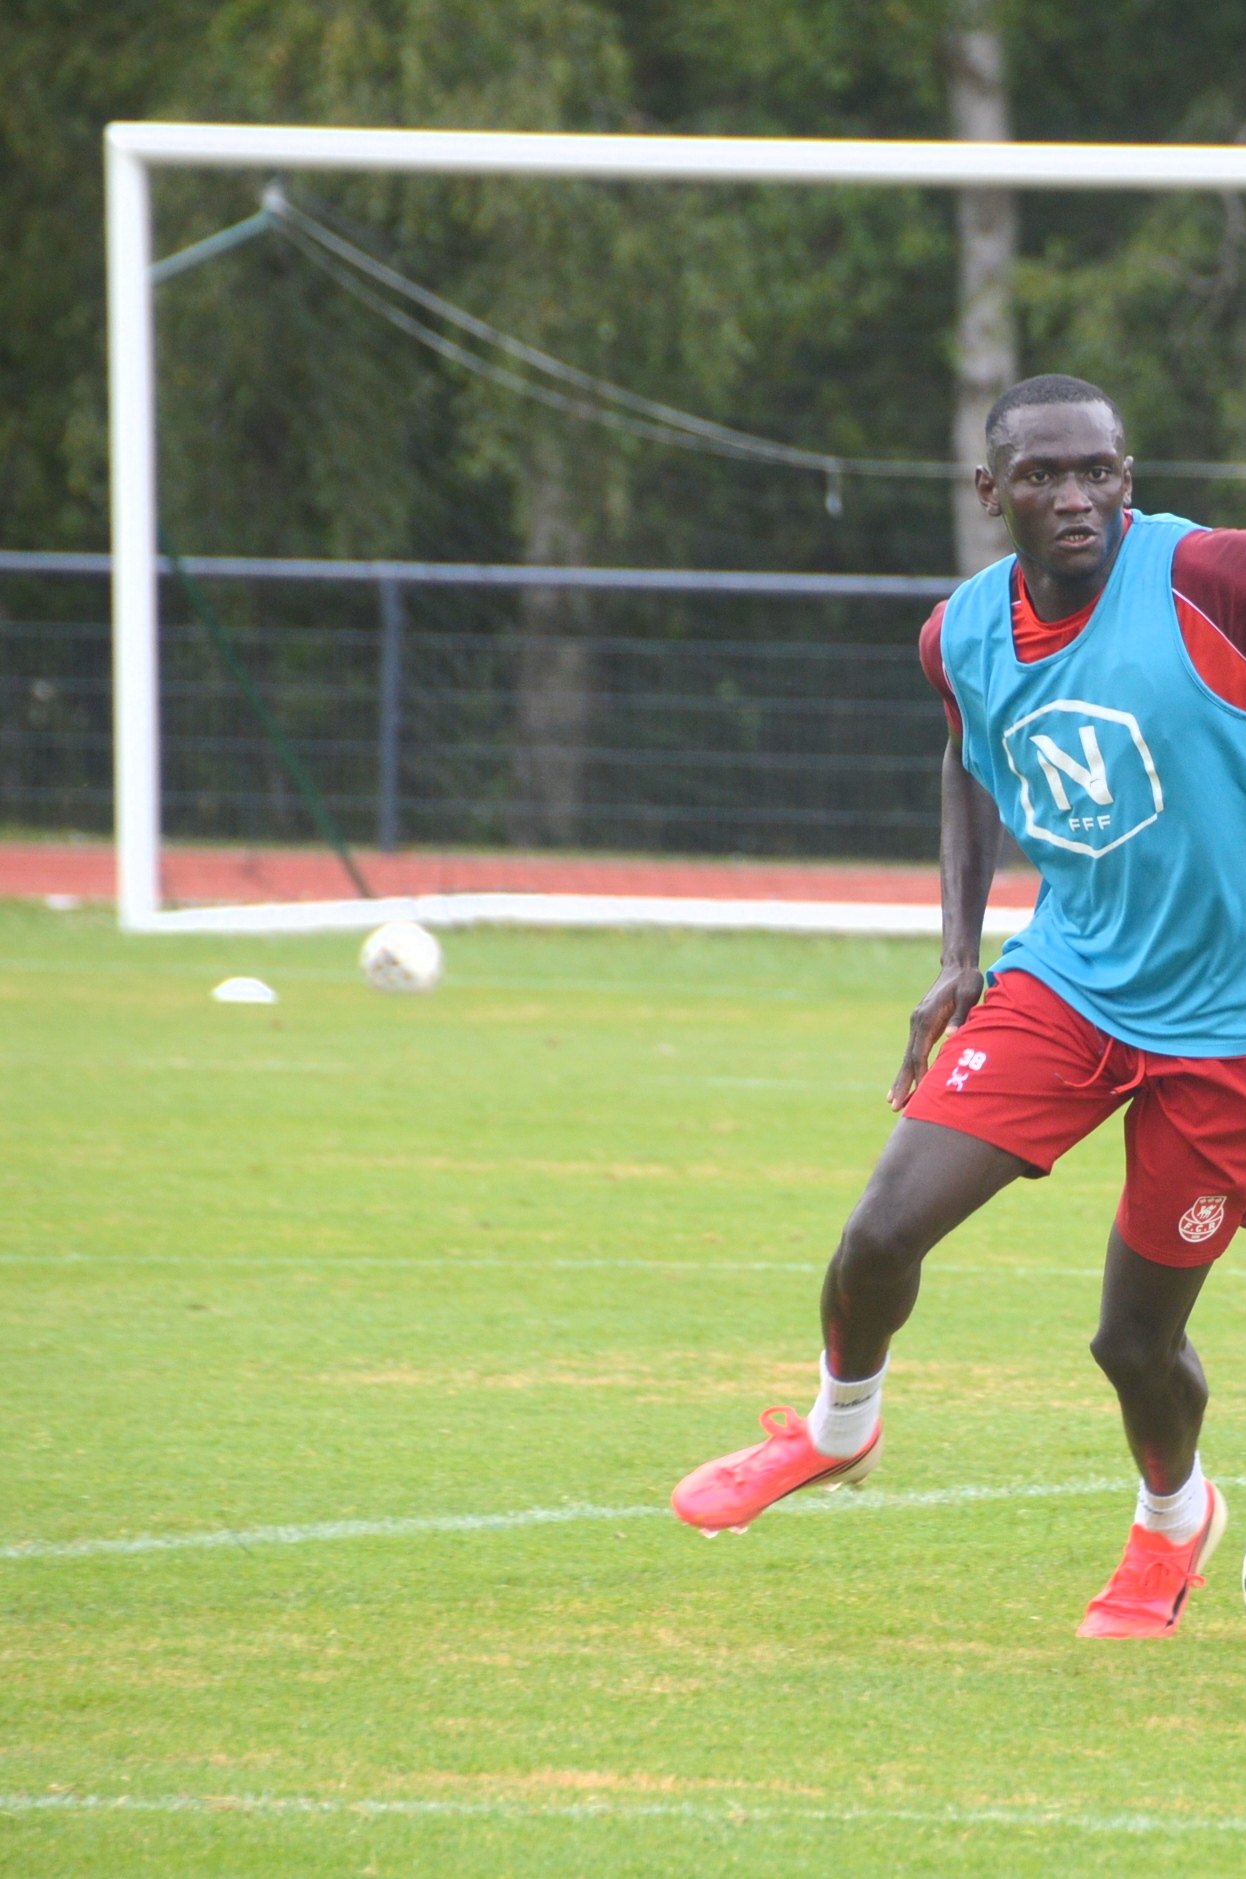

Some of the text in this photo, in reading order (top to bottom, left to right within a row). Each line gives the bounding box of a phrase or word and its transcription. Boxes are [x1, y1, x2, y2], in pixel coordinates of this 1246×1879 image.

[1029, 725, 1114, 811] N
[1068, 814, 1111, 832] FFF
[957, 1047, 987, 1072] 38
